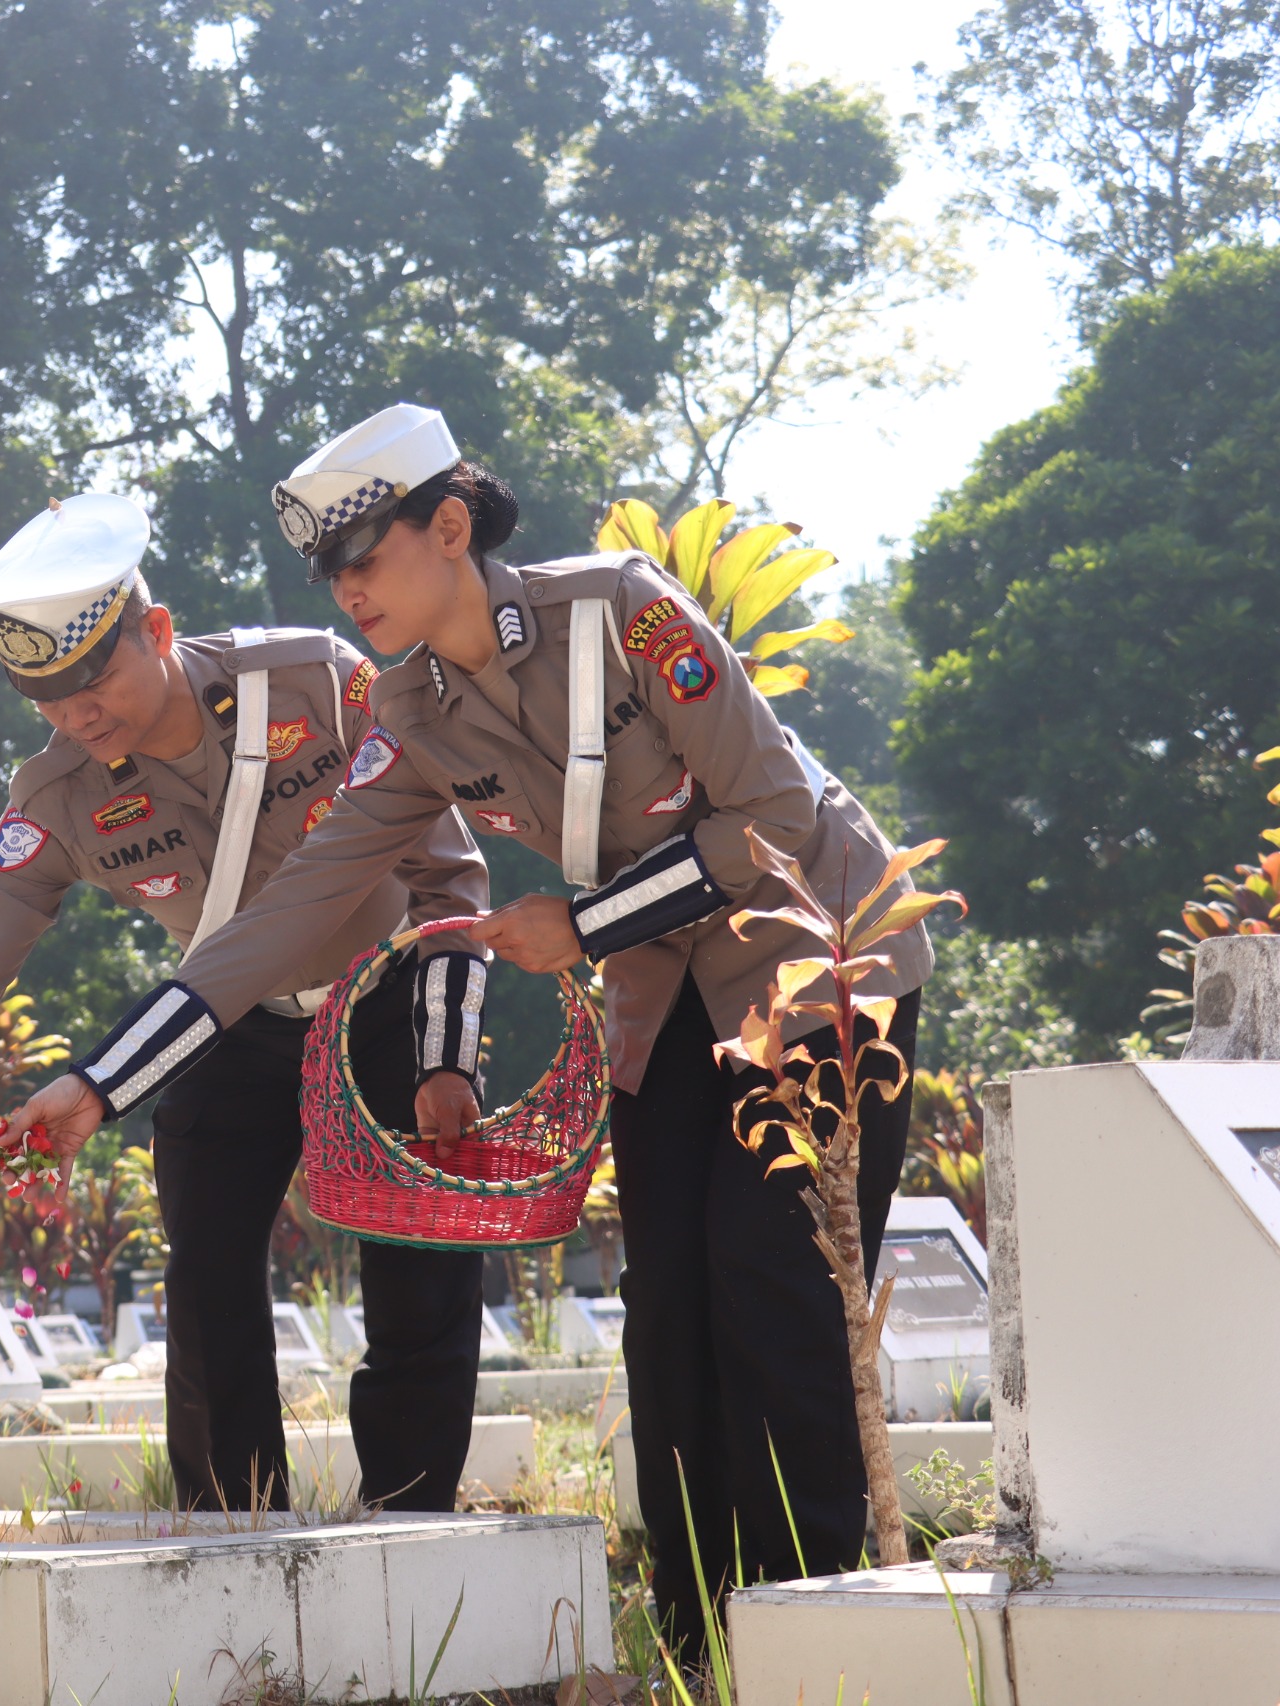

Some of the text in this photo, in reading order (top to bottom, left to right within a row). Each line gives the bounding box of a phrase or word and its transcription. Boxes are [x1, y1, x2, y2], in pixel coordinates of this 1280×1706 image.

[627, 600, 672, 649] POLRES
[637, 609, 675, 650] MALANG
[651, 628, 688, 658] JAWA TIMUR
[348, 660, 372, 700] POLRES
[604, 692, 643, 735] LRI
[260, 749, 342, 813] POLRI
[99, 829, 186, 869] UMAR
